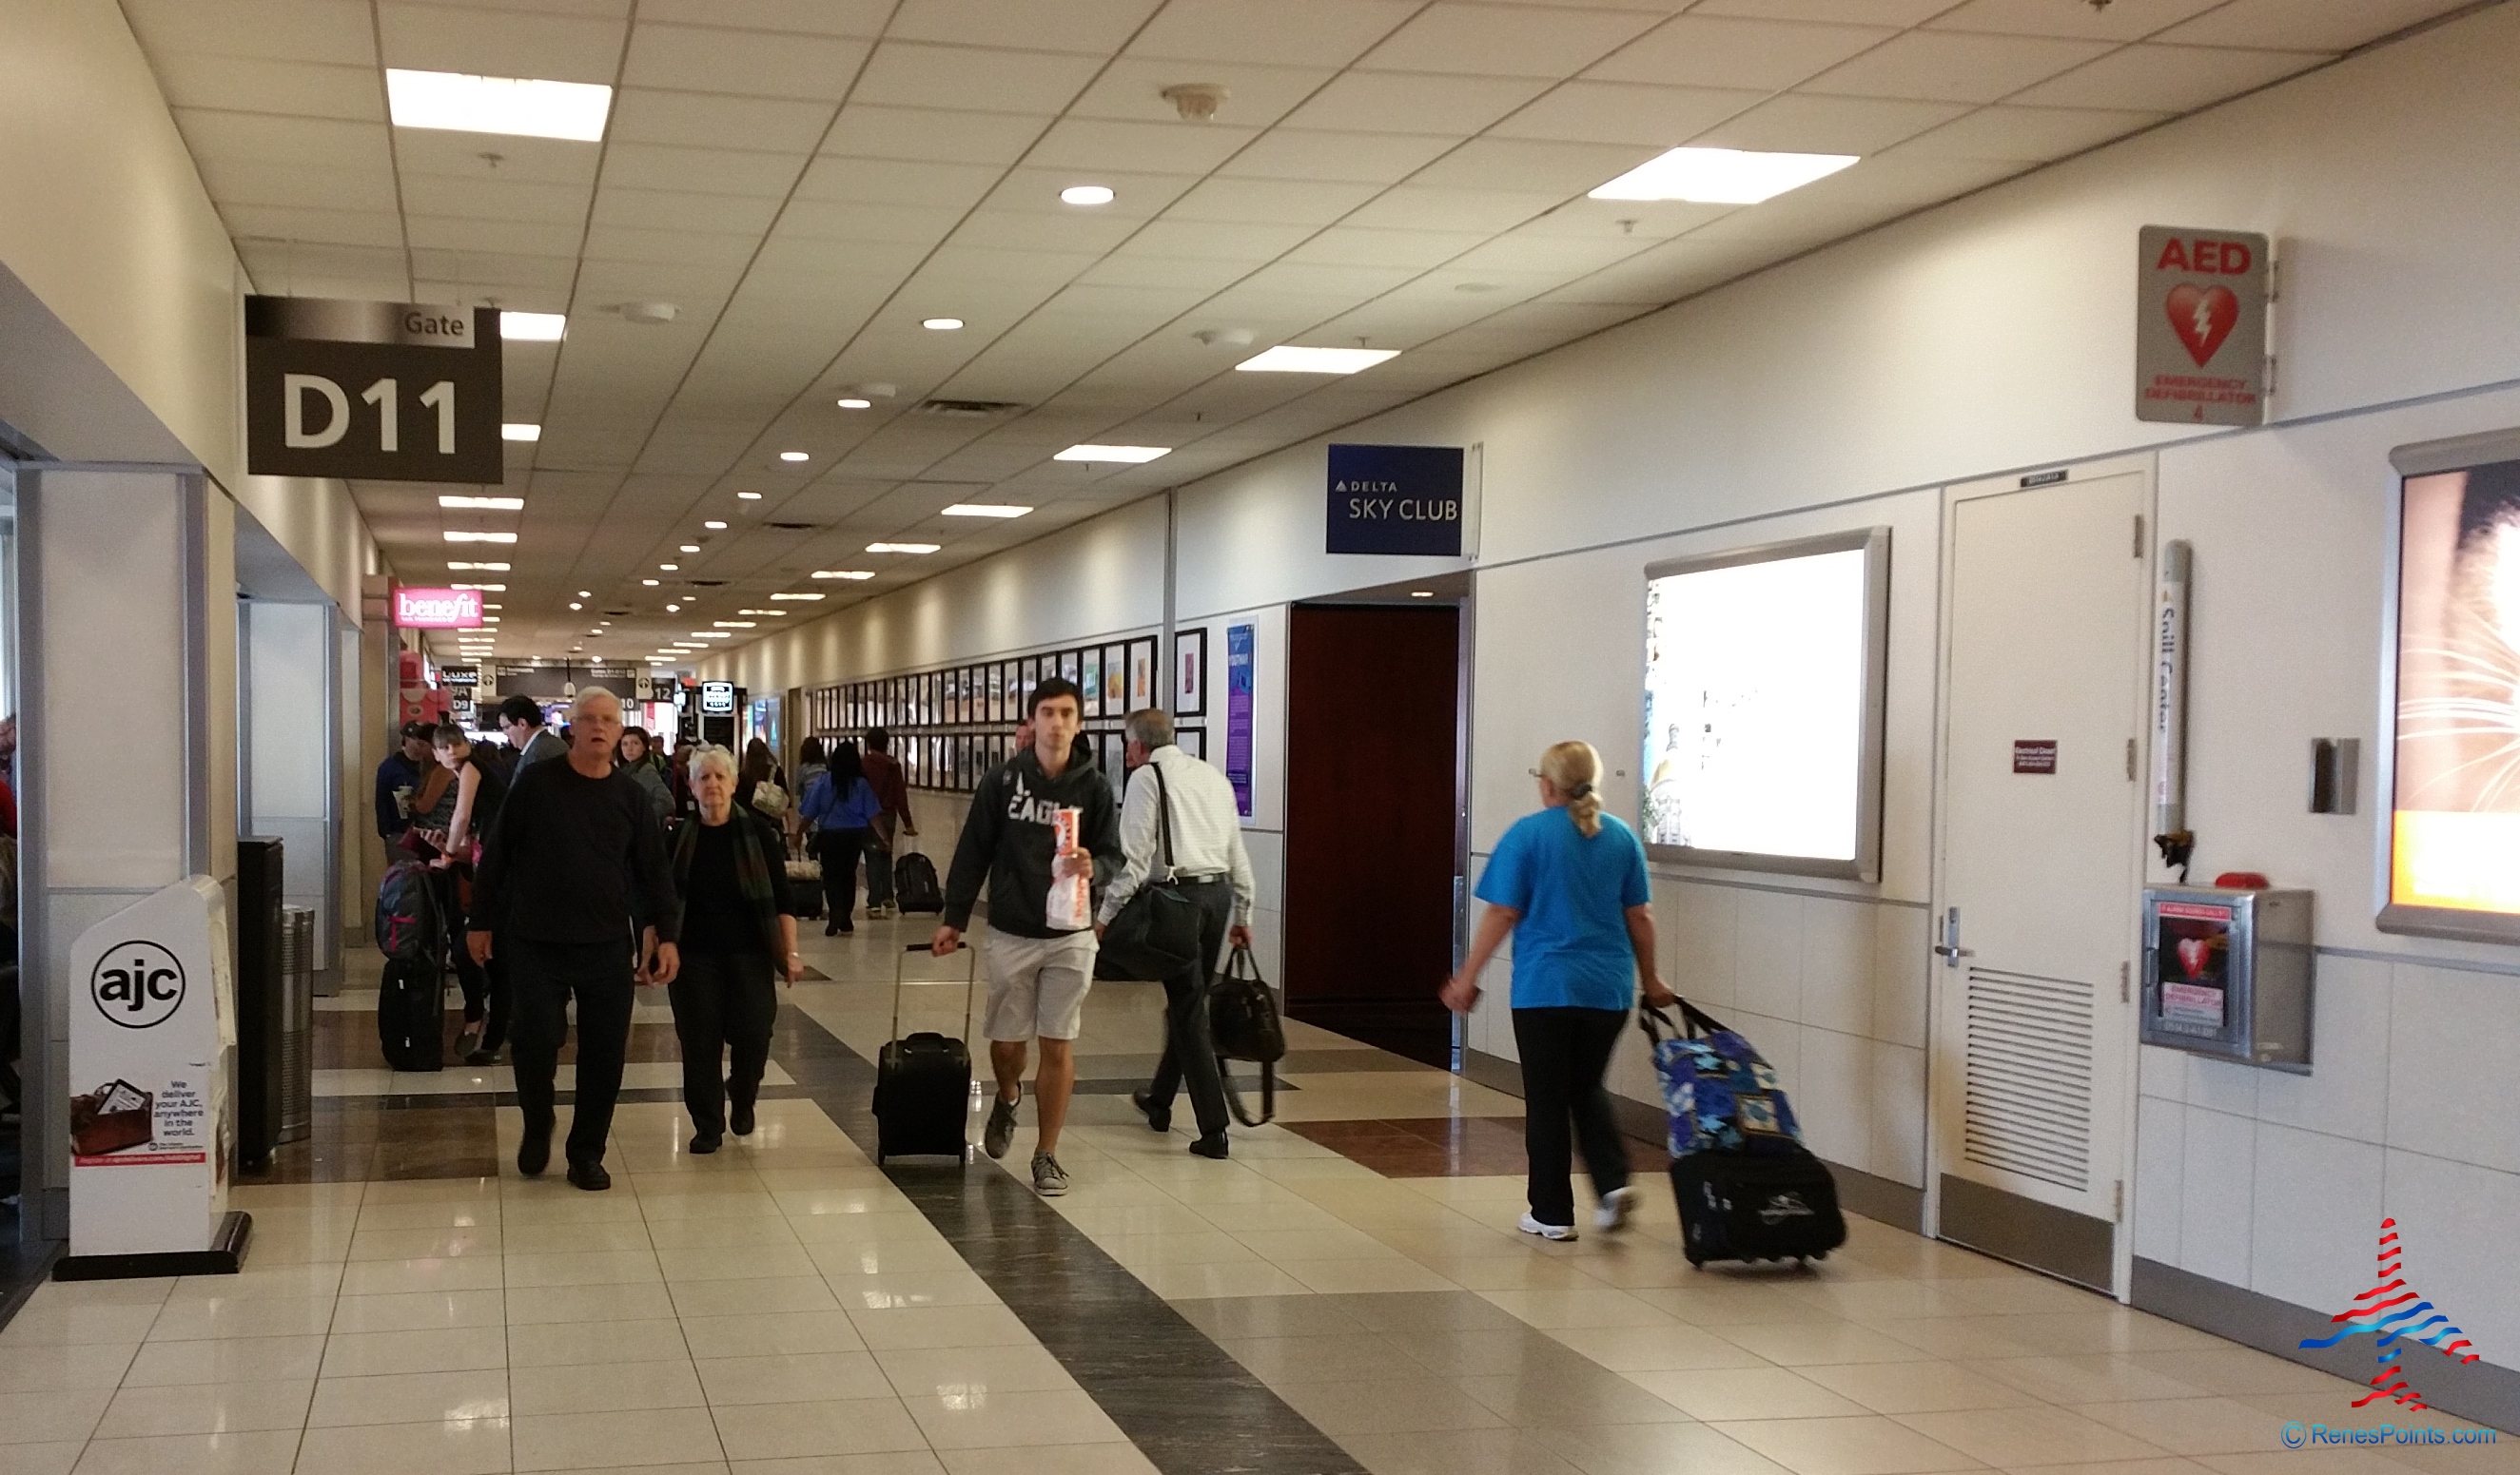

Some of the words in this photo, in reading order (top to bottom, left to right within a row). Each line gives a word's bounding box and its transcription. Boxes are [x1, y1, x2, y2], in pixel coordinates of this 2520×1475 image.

[2157, 238, 2252, 276] AED
[404, 311, 464, 336] Gate
[284, 373, 456, 454] D11
[1351, 480, 1397, 493] DELTA
[1349, 497, 1394, 520] SKY
[1398, 499, 1457, 521] CLUB
[399, 592, 479, 623] benefit
[453, 699, 468, 709] D9
[1008, 794, 1084, 825] EAG
[100, 959, 178, 1012] ajc
[161, 1090, 196, 1098] deliver
[171, 1080, 187, 1089] We
[153, 1109, 205, 1118] anywhere
[155, 1101, 178, 1110] your
